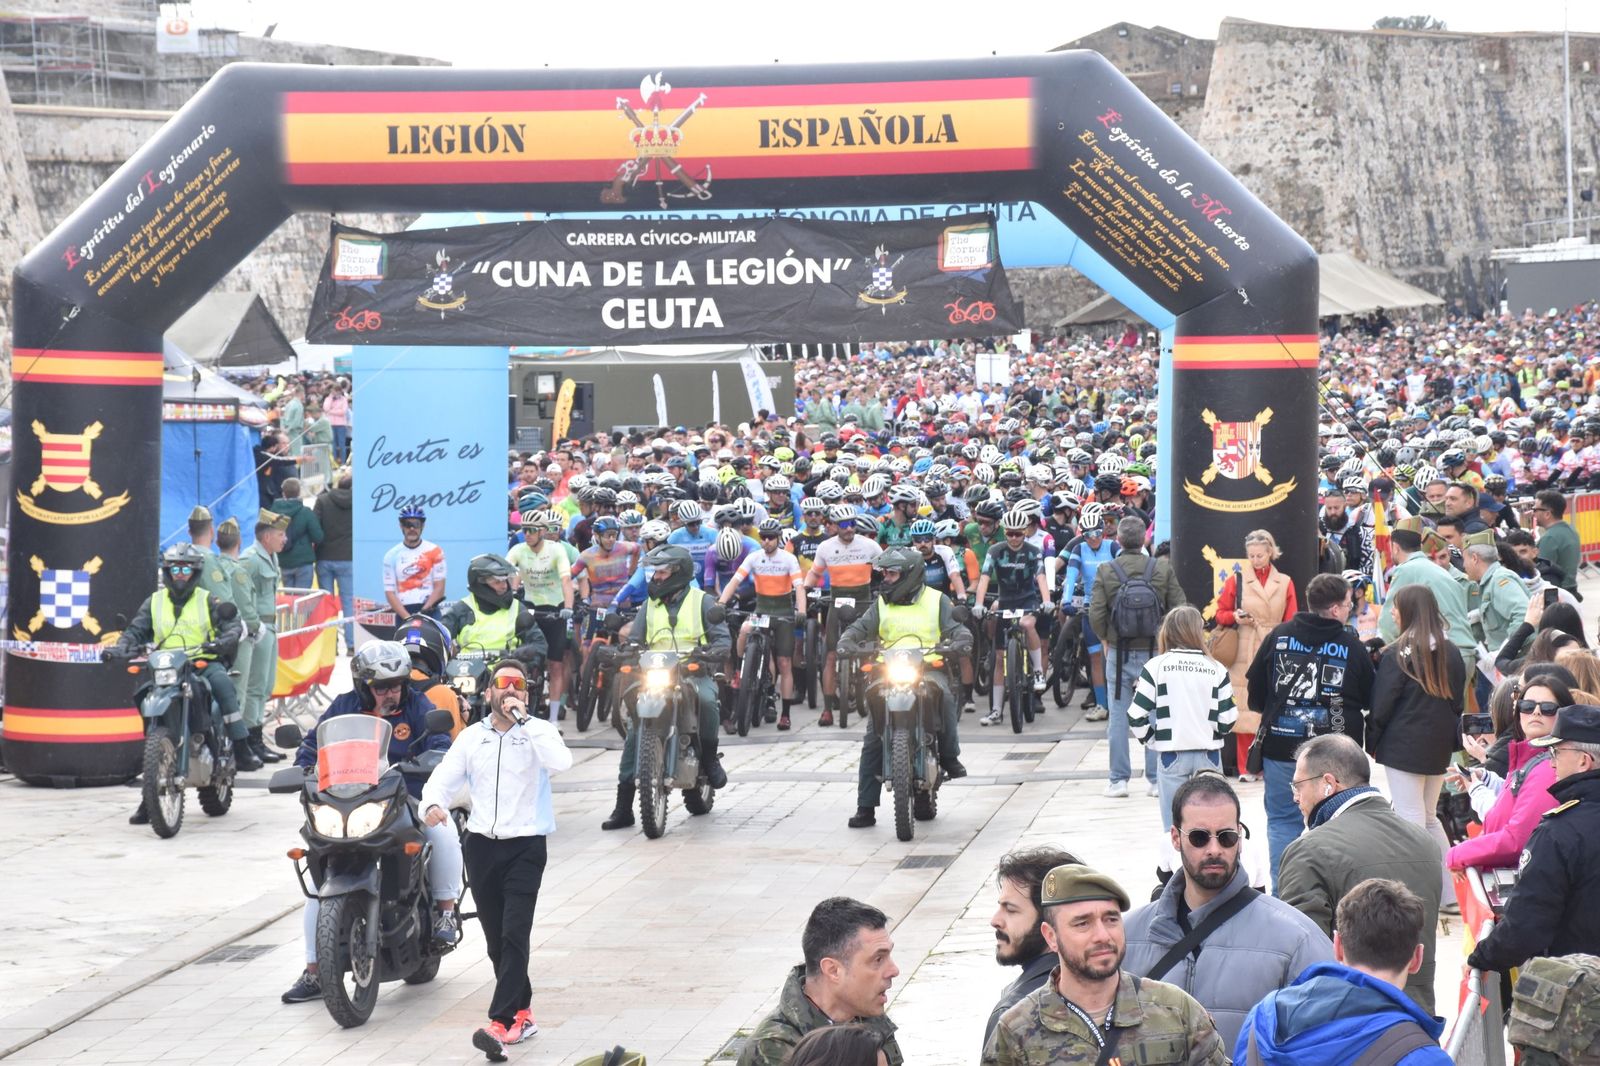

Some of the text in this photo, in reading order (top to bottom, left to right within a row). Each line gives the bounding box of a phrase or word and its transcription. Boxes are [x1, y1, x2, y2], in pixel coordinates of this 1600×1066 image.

[387, 116, 526, 155] LEGIÓN
[758, 109, 958, 148] ESPAÑOLA
[1096, 108, 1250, 251] Espíritu de la Muerte
[62, 123, 216, 270] Espíritu del Legionario
[566, 229, 756, 246] CARRERA CÍVICO-MILITAR
[603, 260, 645, 287] DE
[655, 260, 695, 287] LA
[601, 297, 724, 330] CEUTA
[367, 435, 485, 469] Ceuta es
[371, 480, 486, 513] Deporte
[1195, 667, 1216, 675] SANTO
